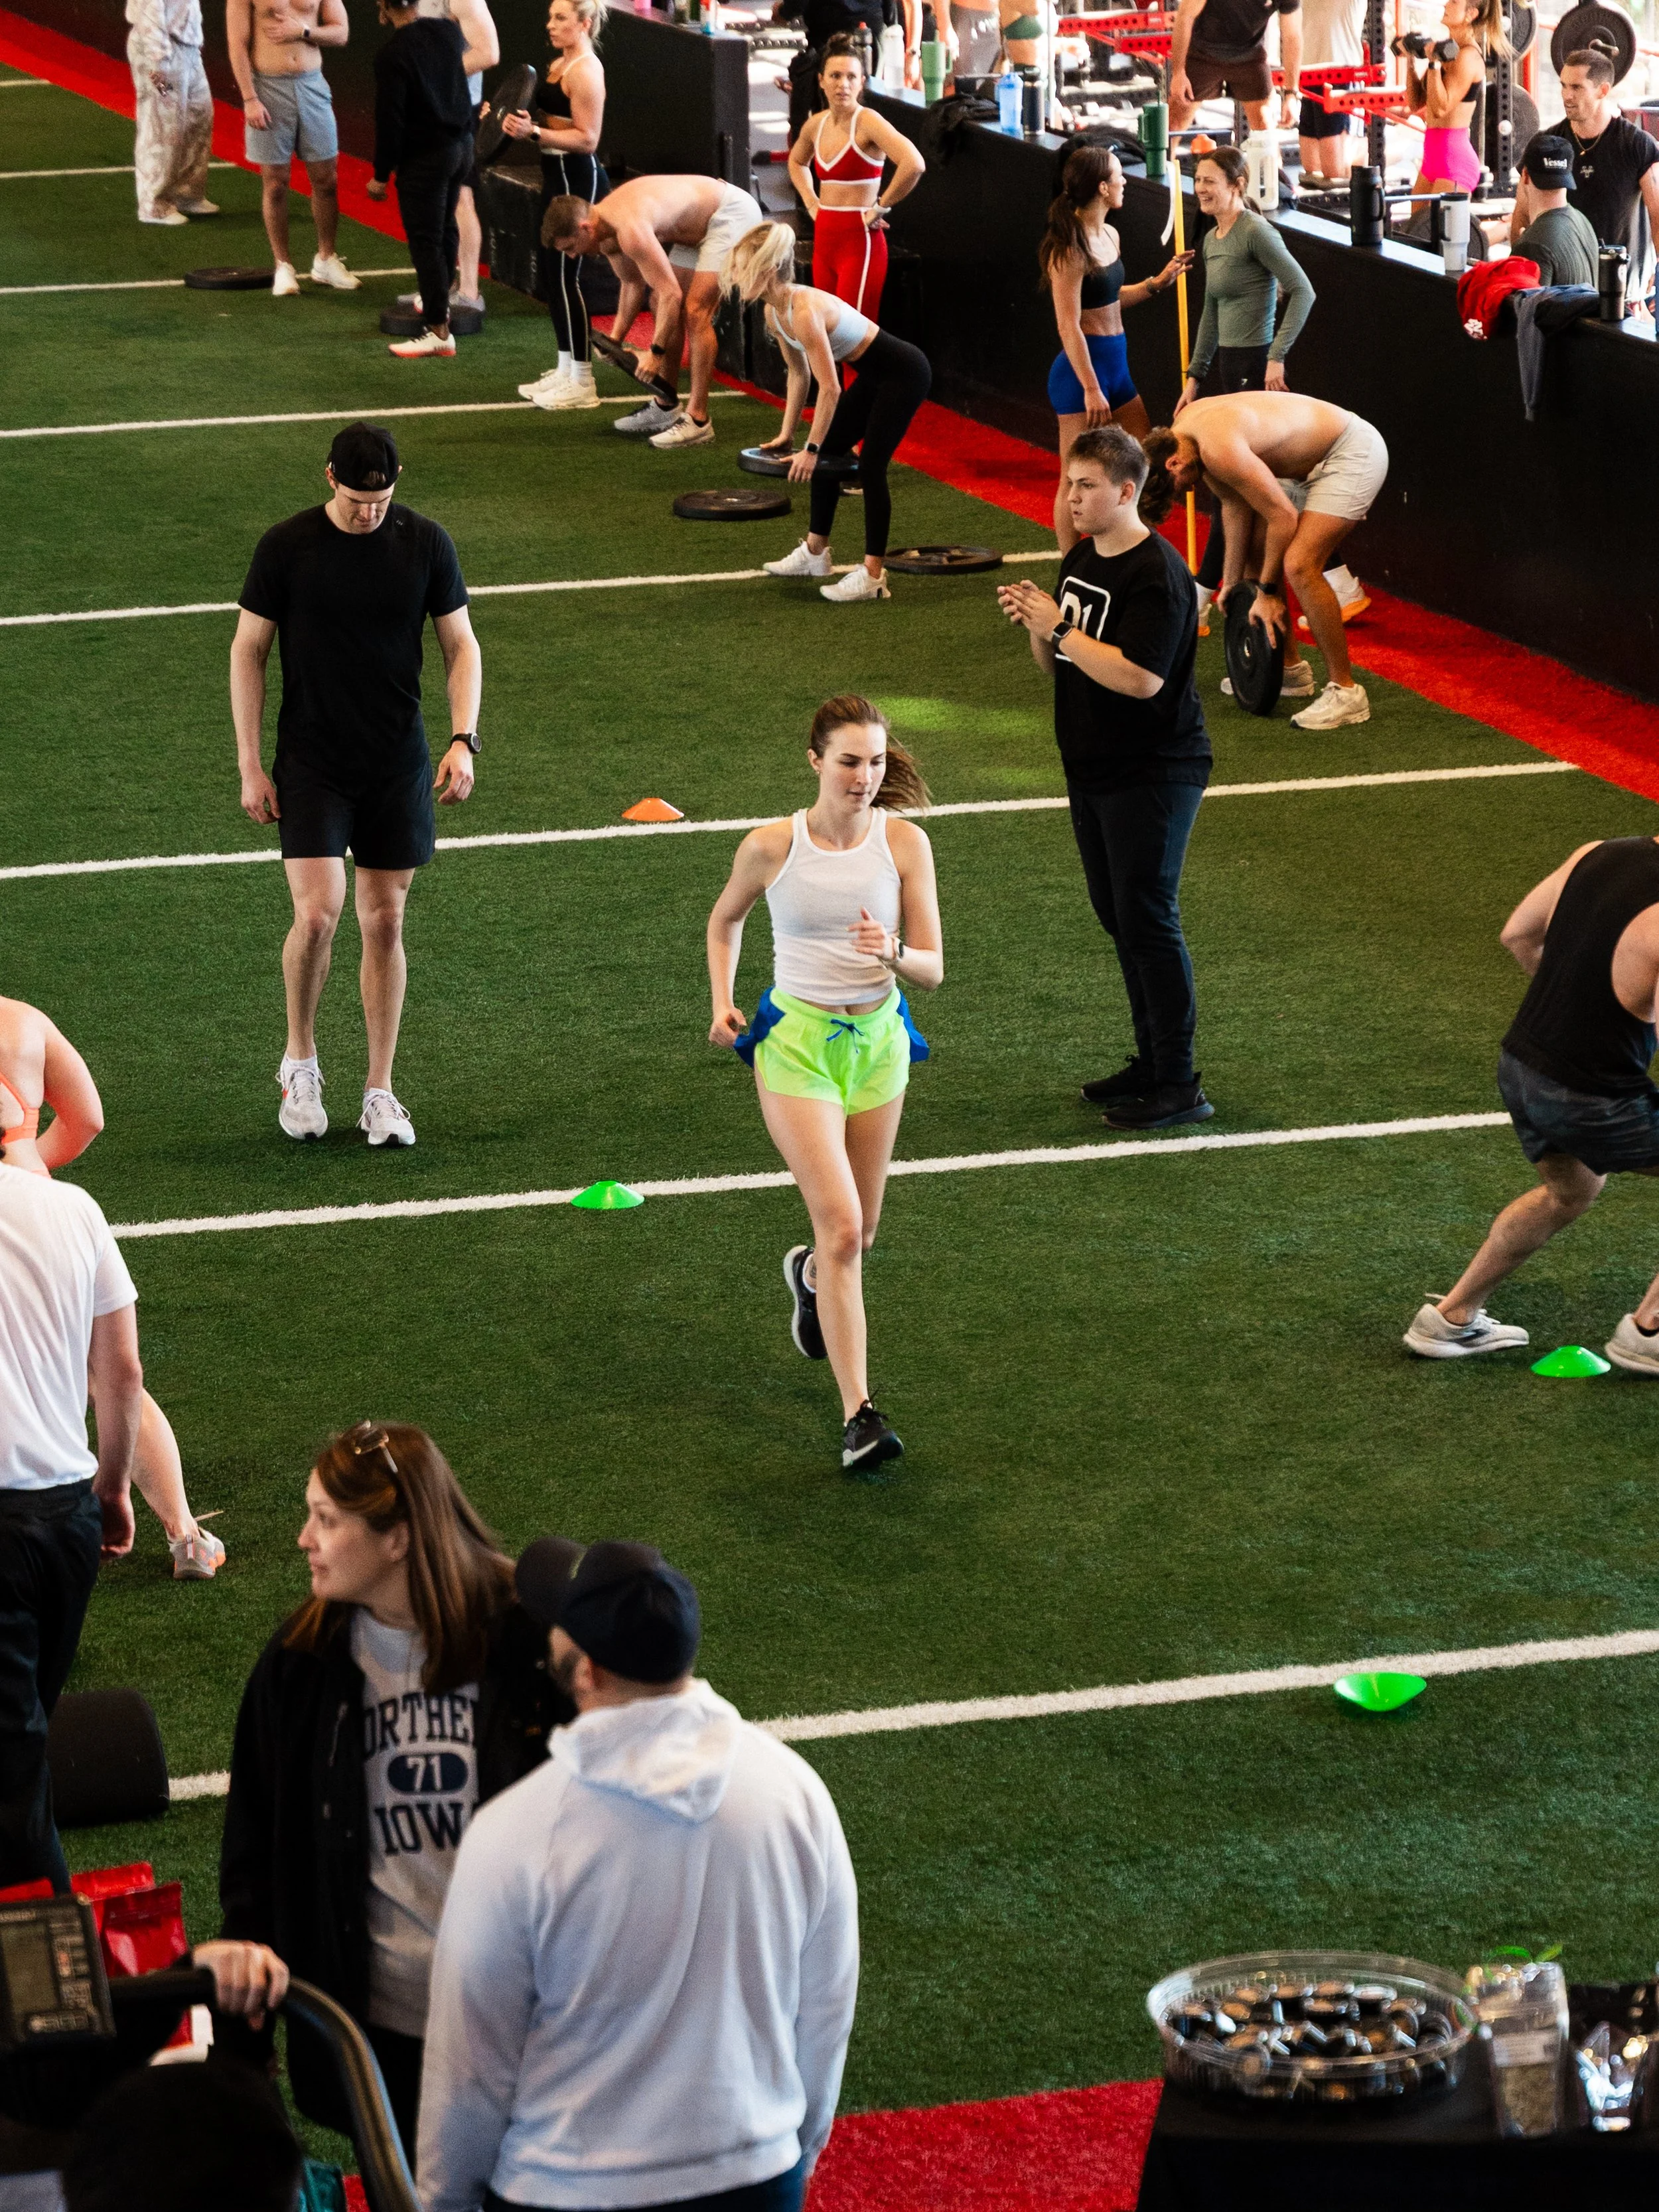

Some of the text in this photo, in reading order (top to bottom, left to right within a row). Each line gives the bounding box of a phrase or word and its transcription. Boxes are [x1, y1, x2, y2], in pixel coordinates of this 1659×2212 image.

[1060, 591, 1094, 634] D1
[364, 1692, 475, 1759] ORTHE
[406, 1755, 443, 1792] 71
[374, 1802, 473, 1854] IOW
